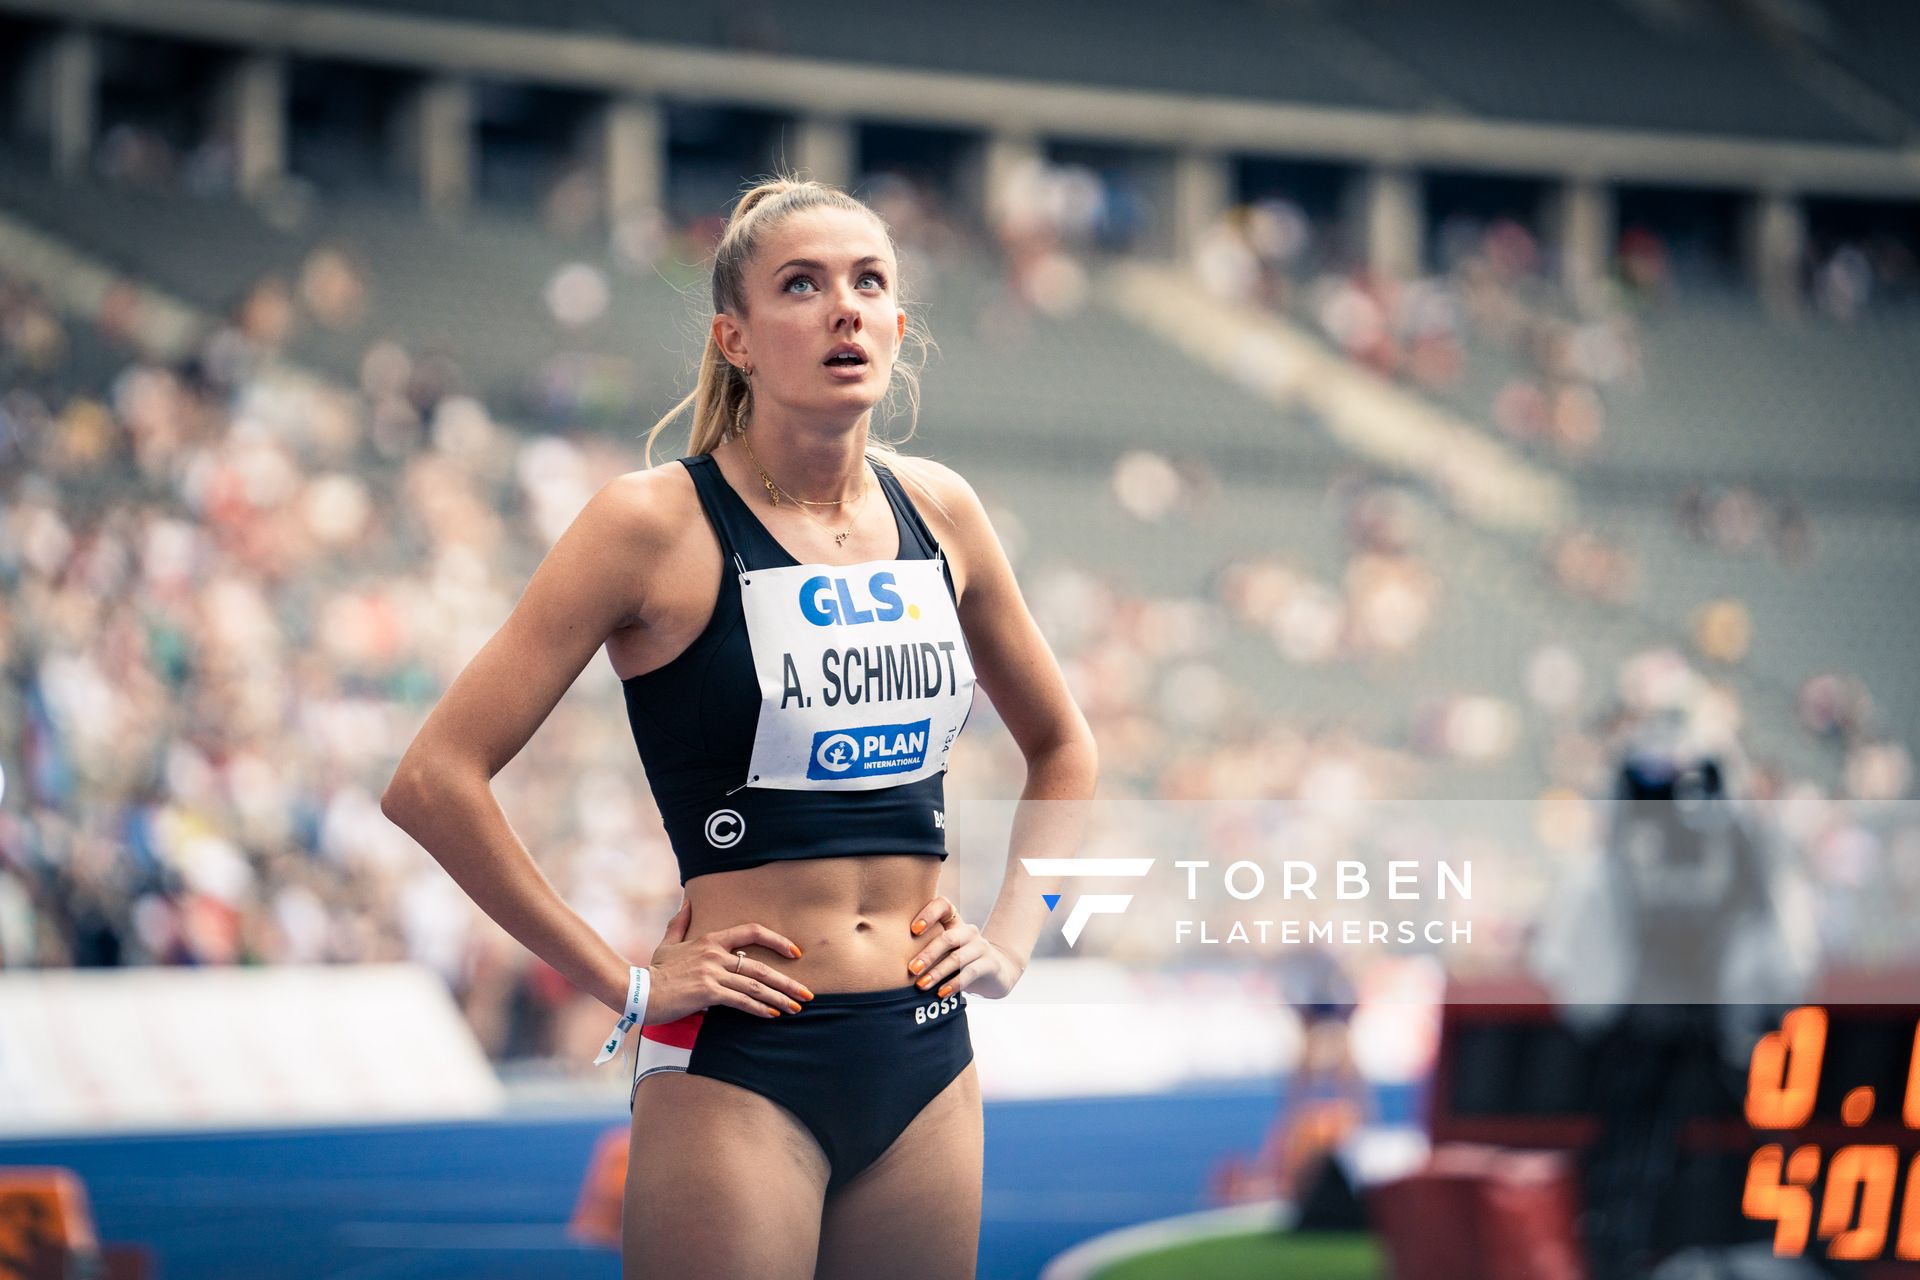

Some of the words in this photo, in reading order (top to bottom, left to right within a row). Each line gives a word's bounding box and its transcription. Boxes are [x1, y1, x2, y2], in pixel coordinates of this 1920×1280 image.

[780, 652, 812, 710] A.
[822, 641, 957, 707] SCHMIDT
[863, 731, 926, 758] PLAN
[863, 757, 921, 770] INTERNATIONAL
[914, 993, 959, 1025] BOSS
